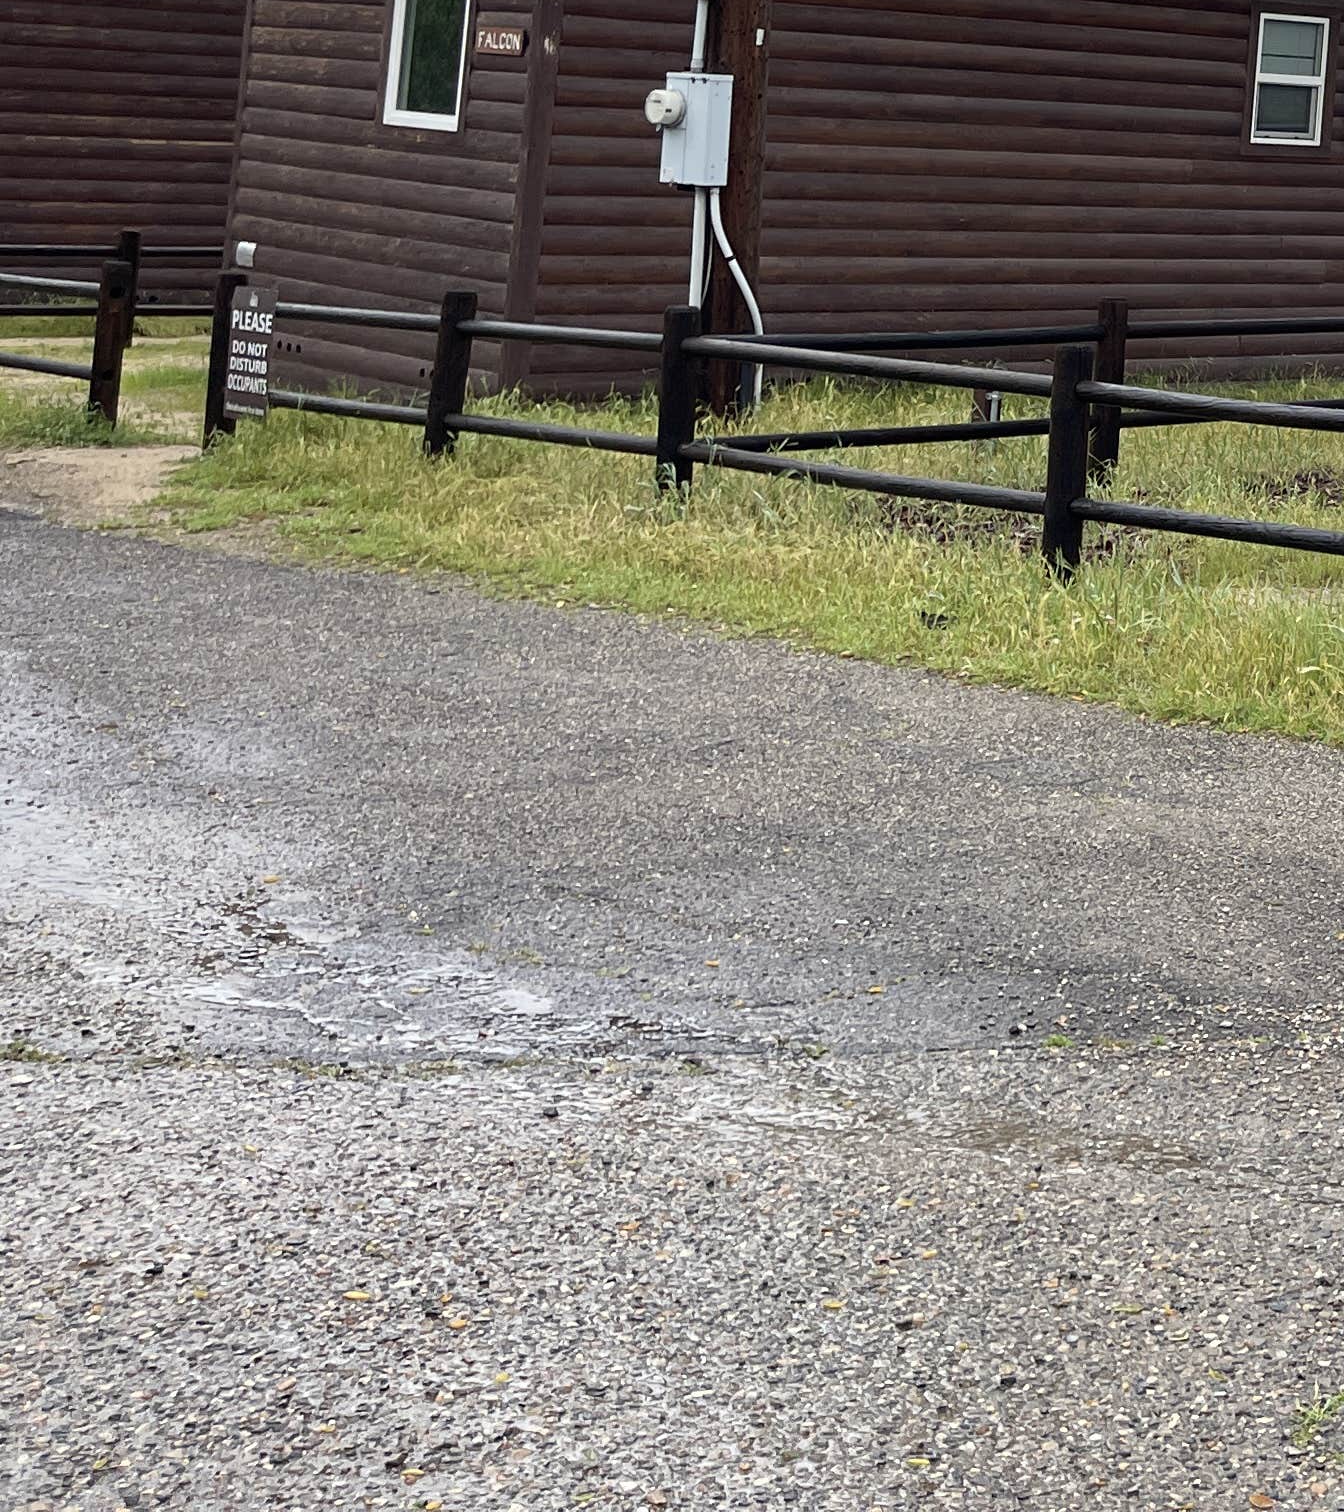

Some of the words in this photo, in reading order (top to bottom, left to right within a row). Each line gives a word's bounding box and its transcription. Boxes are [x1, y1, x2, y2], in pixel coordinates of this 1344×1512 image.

[478, 31, 521, 51] FALCON
[232, 309, 273, 334] PLEASE
[232, 339, 246, 355] DO
[247, 342, 268, 358] NOT
[229, 356, 268, 375] DISTURB
[227, 373, 268, 395] OCCUPANTS
